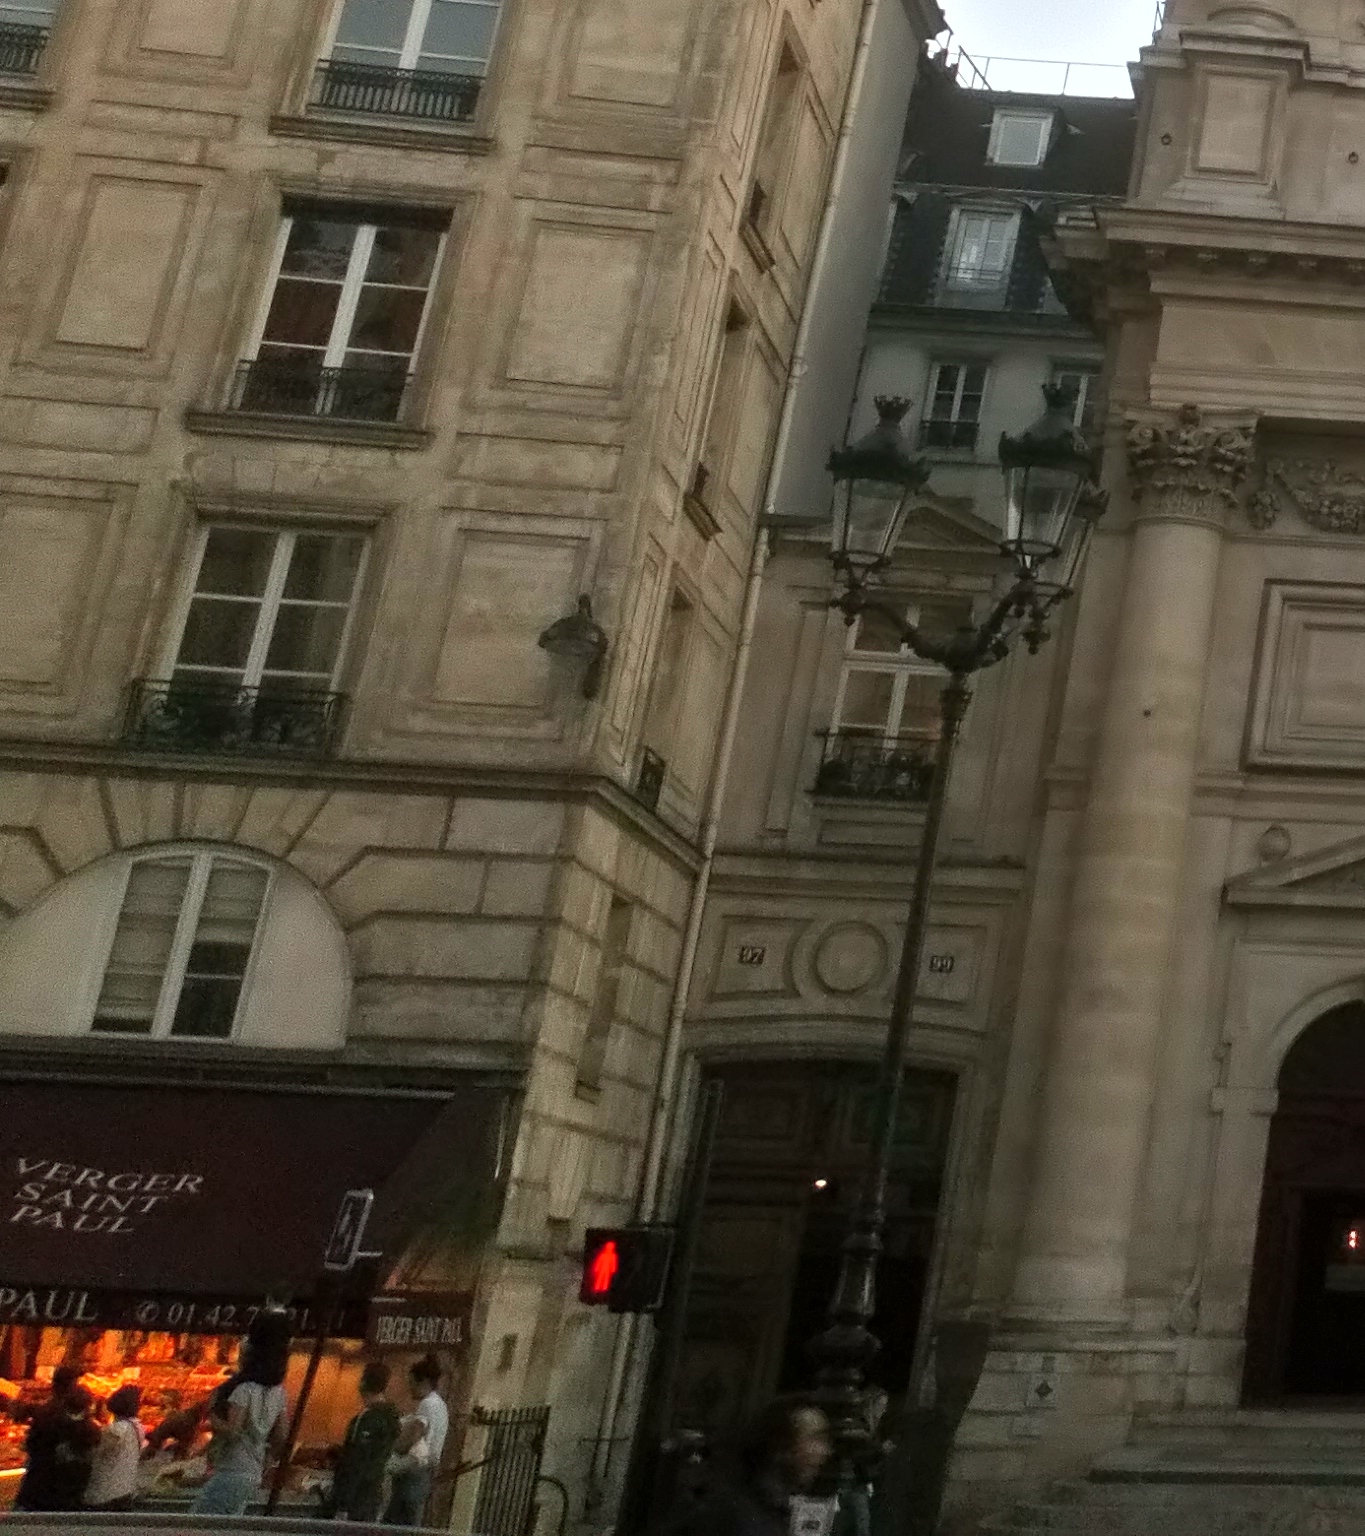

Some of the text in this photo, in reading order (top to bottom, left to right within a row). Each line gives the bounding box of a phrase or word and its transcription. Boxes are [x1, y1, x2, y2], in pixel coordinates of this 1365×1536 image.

[17, 1157, 204, 1194] VERGER
[14, 1182, 169, 1213] SAINT
[10, 1204, 135, 1233] PAUL
[0, 1287, 99, 1322] PAUL
